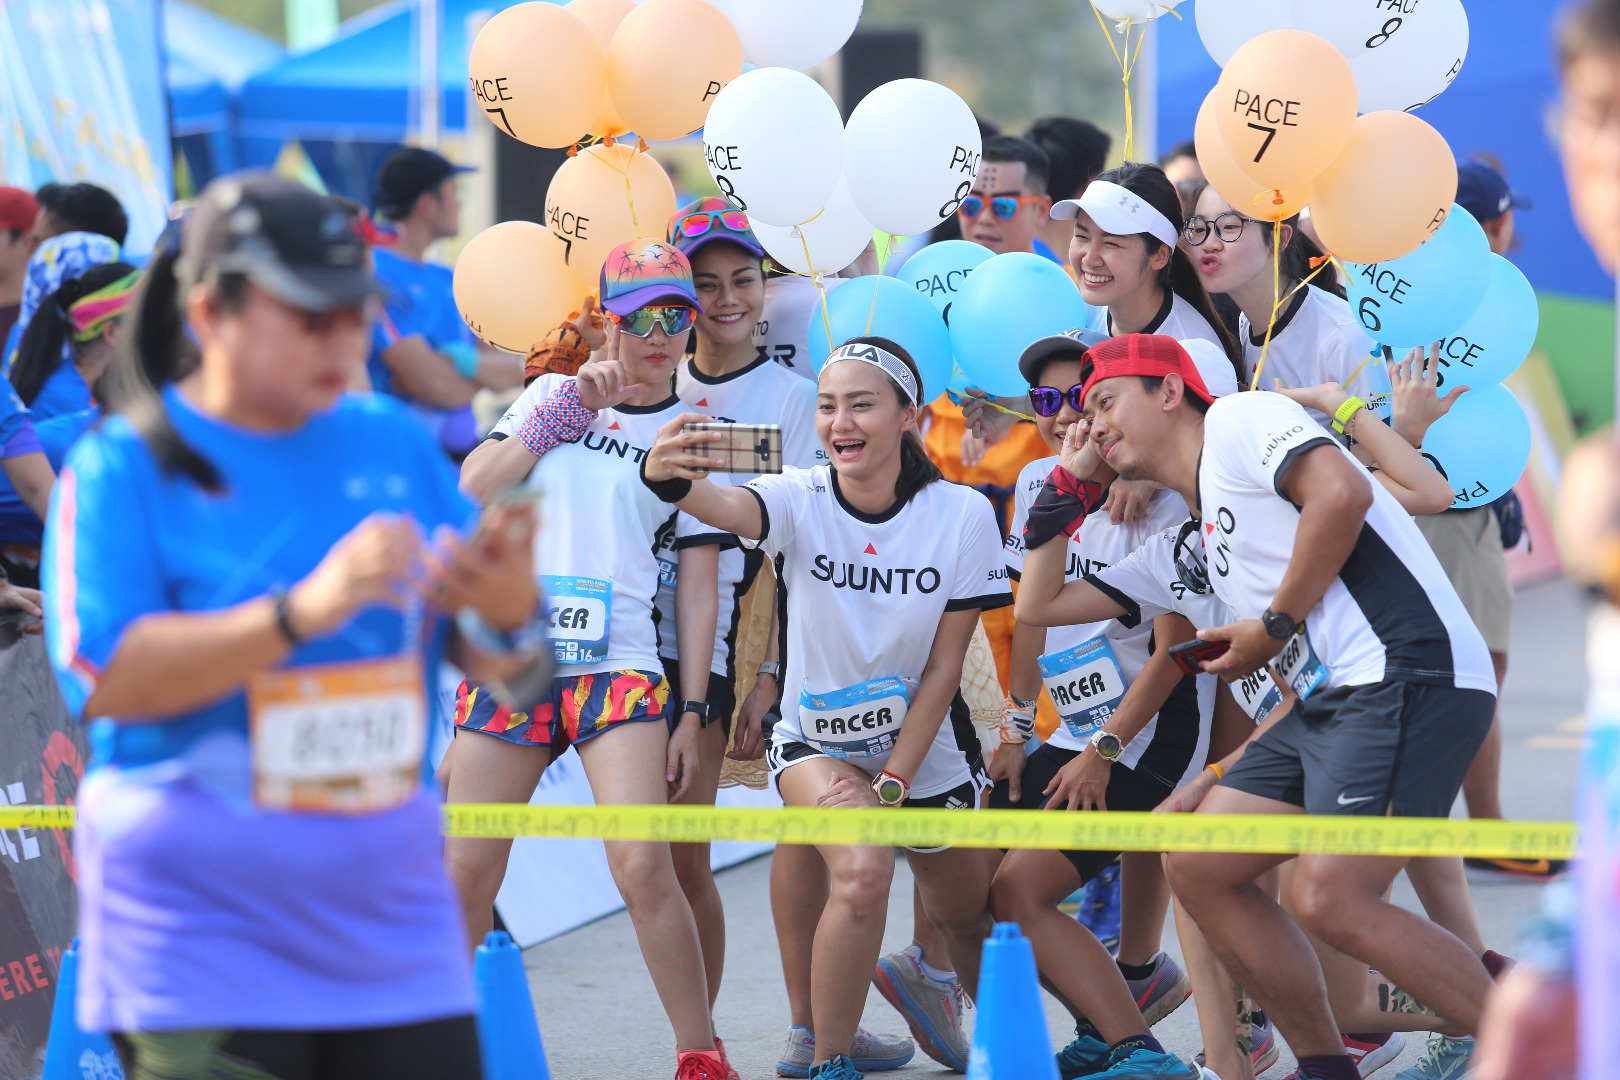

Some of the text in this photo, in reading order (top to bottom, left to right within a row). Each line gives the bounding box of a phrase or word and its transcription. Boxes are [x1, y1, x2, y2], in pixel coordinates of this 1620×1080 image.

[1366, 17, 1402, 48] 8
[470, 77, 513, 102] PACE
[1234, 88, 1301, 127] PACE
[485, 107, 518, 137] 7
[703, 145, 743, 171] PACE
[1247, 122, 1277, 163] 7
[949, 145, 983, 178] PAC
[716, 174, 748, 211] 8
[938, 180, 971, 219] 8
[546, 198, 590, 240] PACE
[553, 231, 572, 267] 7
[1354, 262, 1412, 304] ACE
[1358, 296, 1382, 332] 6
[825, 344, 879, 366] FILA
[1261, 425, 1304, 468] SUUNTO
[1453, 480, 1488, 505] PA
[810, 554, 941, 595] SUUNTO
[580, 648, 593, 663] 16
[1050, 671, 1106, 707] PACER
[815, 707, 893, 735] PACER
